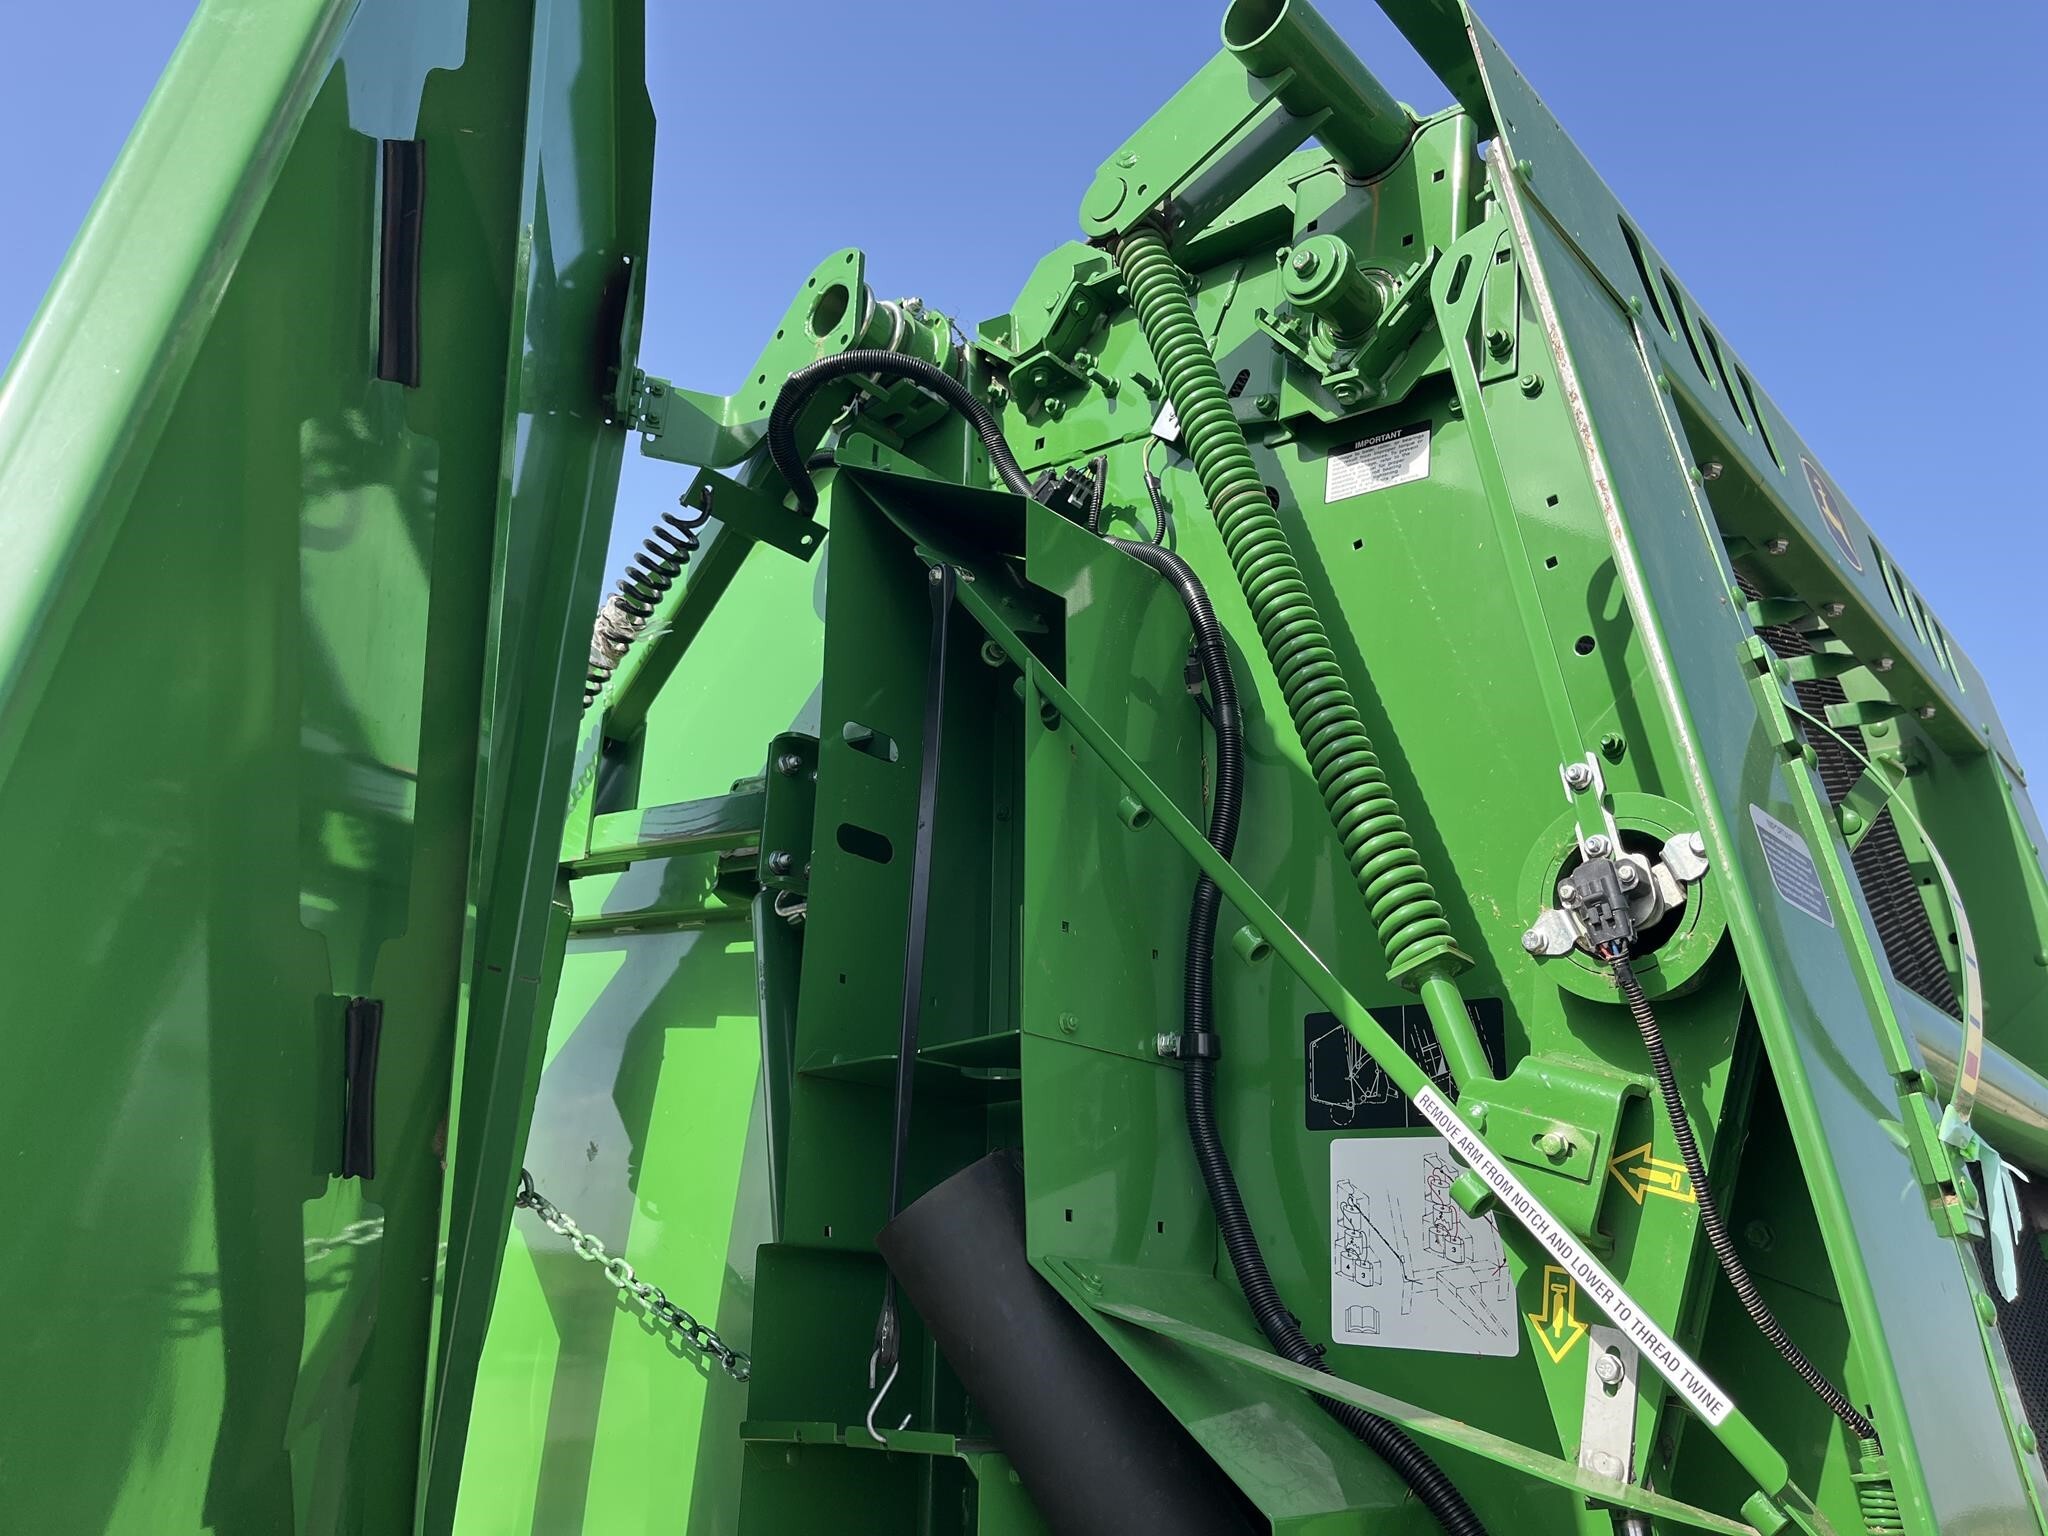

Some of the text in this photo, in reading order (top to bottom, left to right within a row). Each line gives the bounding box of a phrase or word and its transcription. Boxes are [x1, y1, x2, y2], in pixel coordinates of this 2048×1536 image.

[1355, 429, 1402, 449] IMPORTANT
[1419, 1094, 1723, 1416] REMOVE ARM FROM NOTCH AND LOWER TO THREAD TWINE
